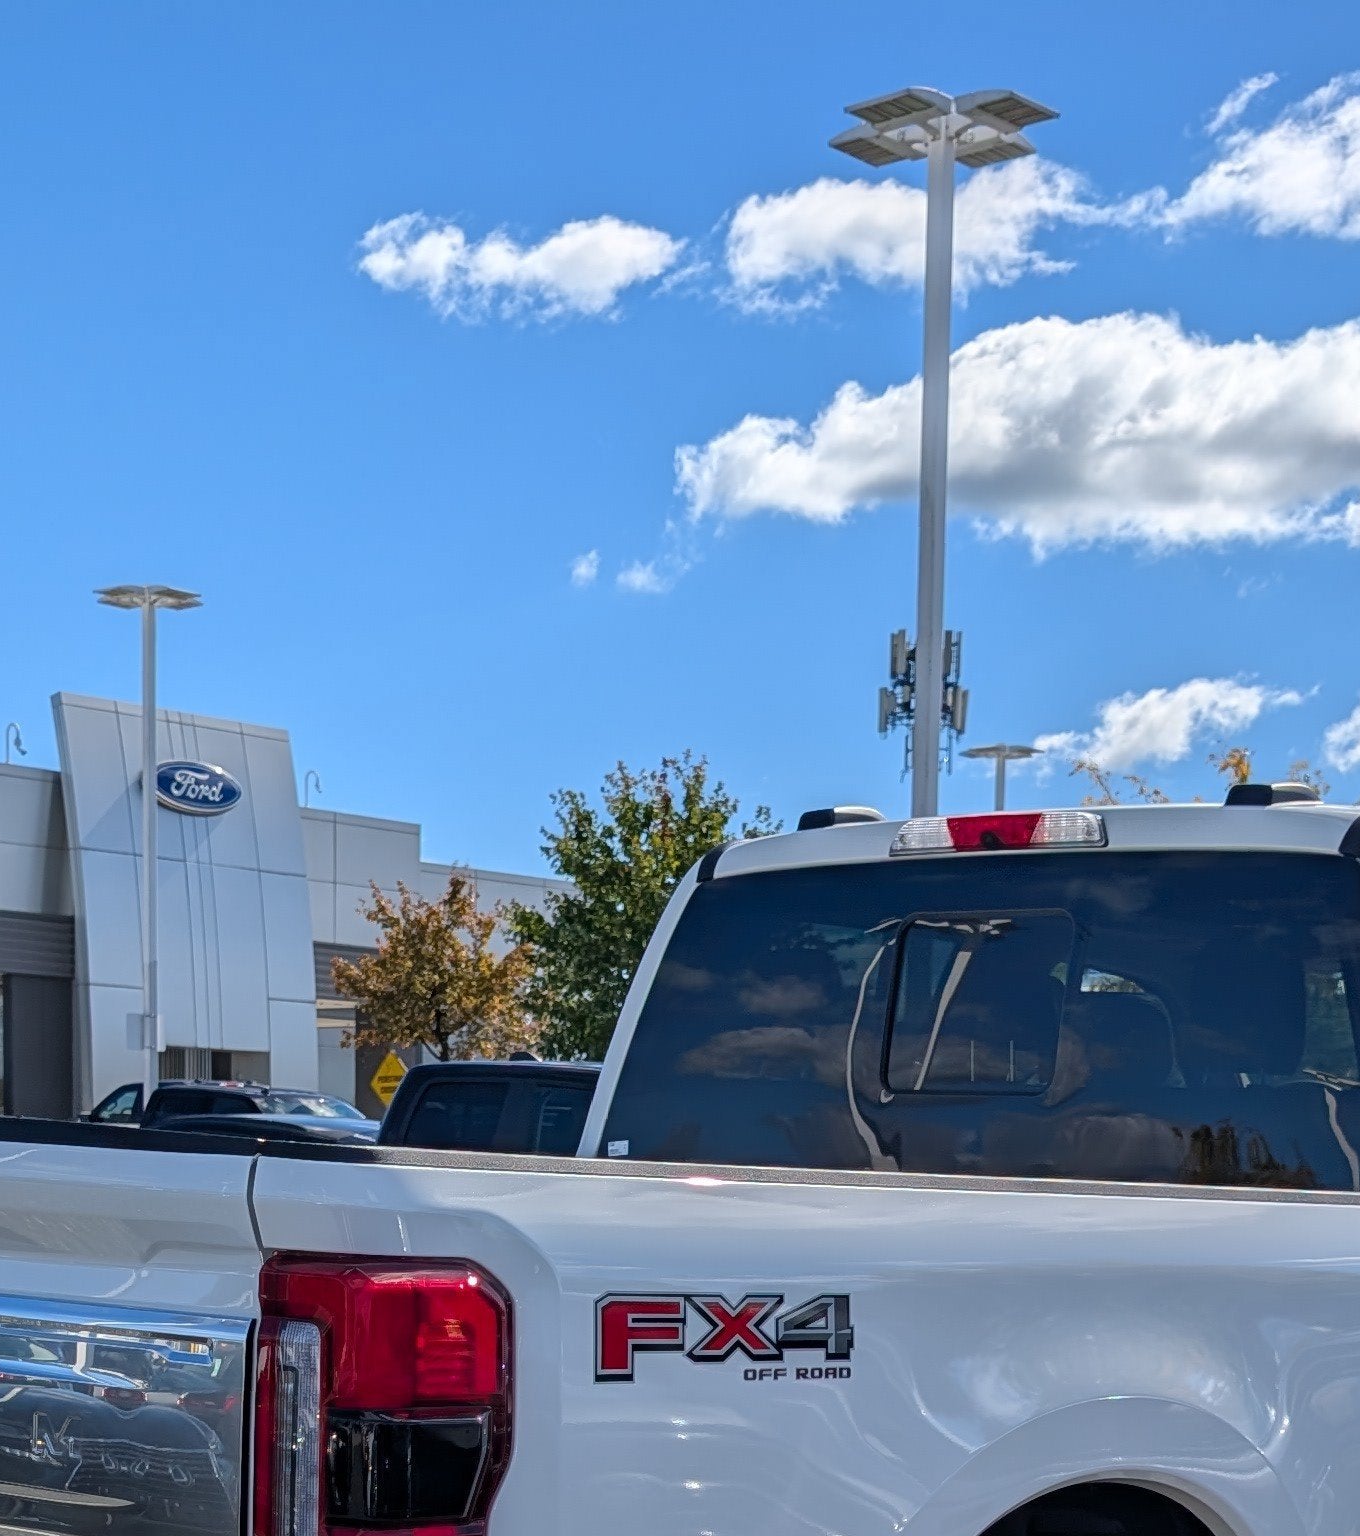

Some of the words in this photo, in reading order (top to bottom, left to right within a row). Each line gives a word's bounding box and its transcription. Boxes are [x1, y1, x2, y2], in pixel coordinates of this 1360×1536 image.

[171, 770, 224, 802] Ford
[593, 1291, 854, 1384] FX4
[744, 1368, 787, 1381] OFF
[795, 1366, 851, 1380] ROAD
